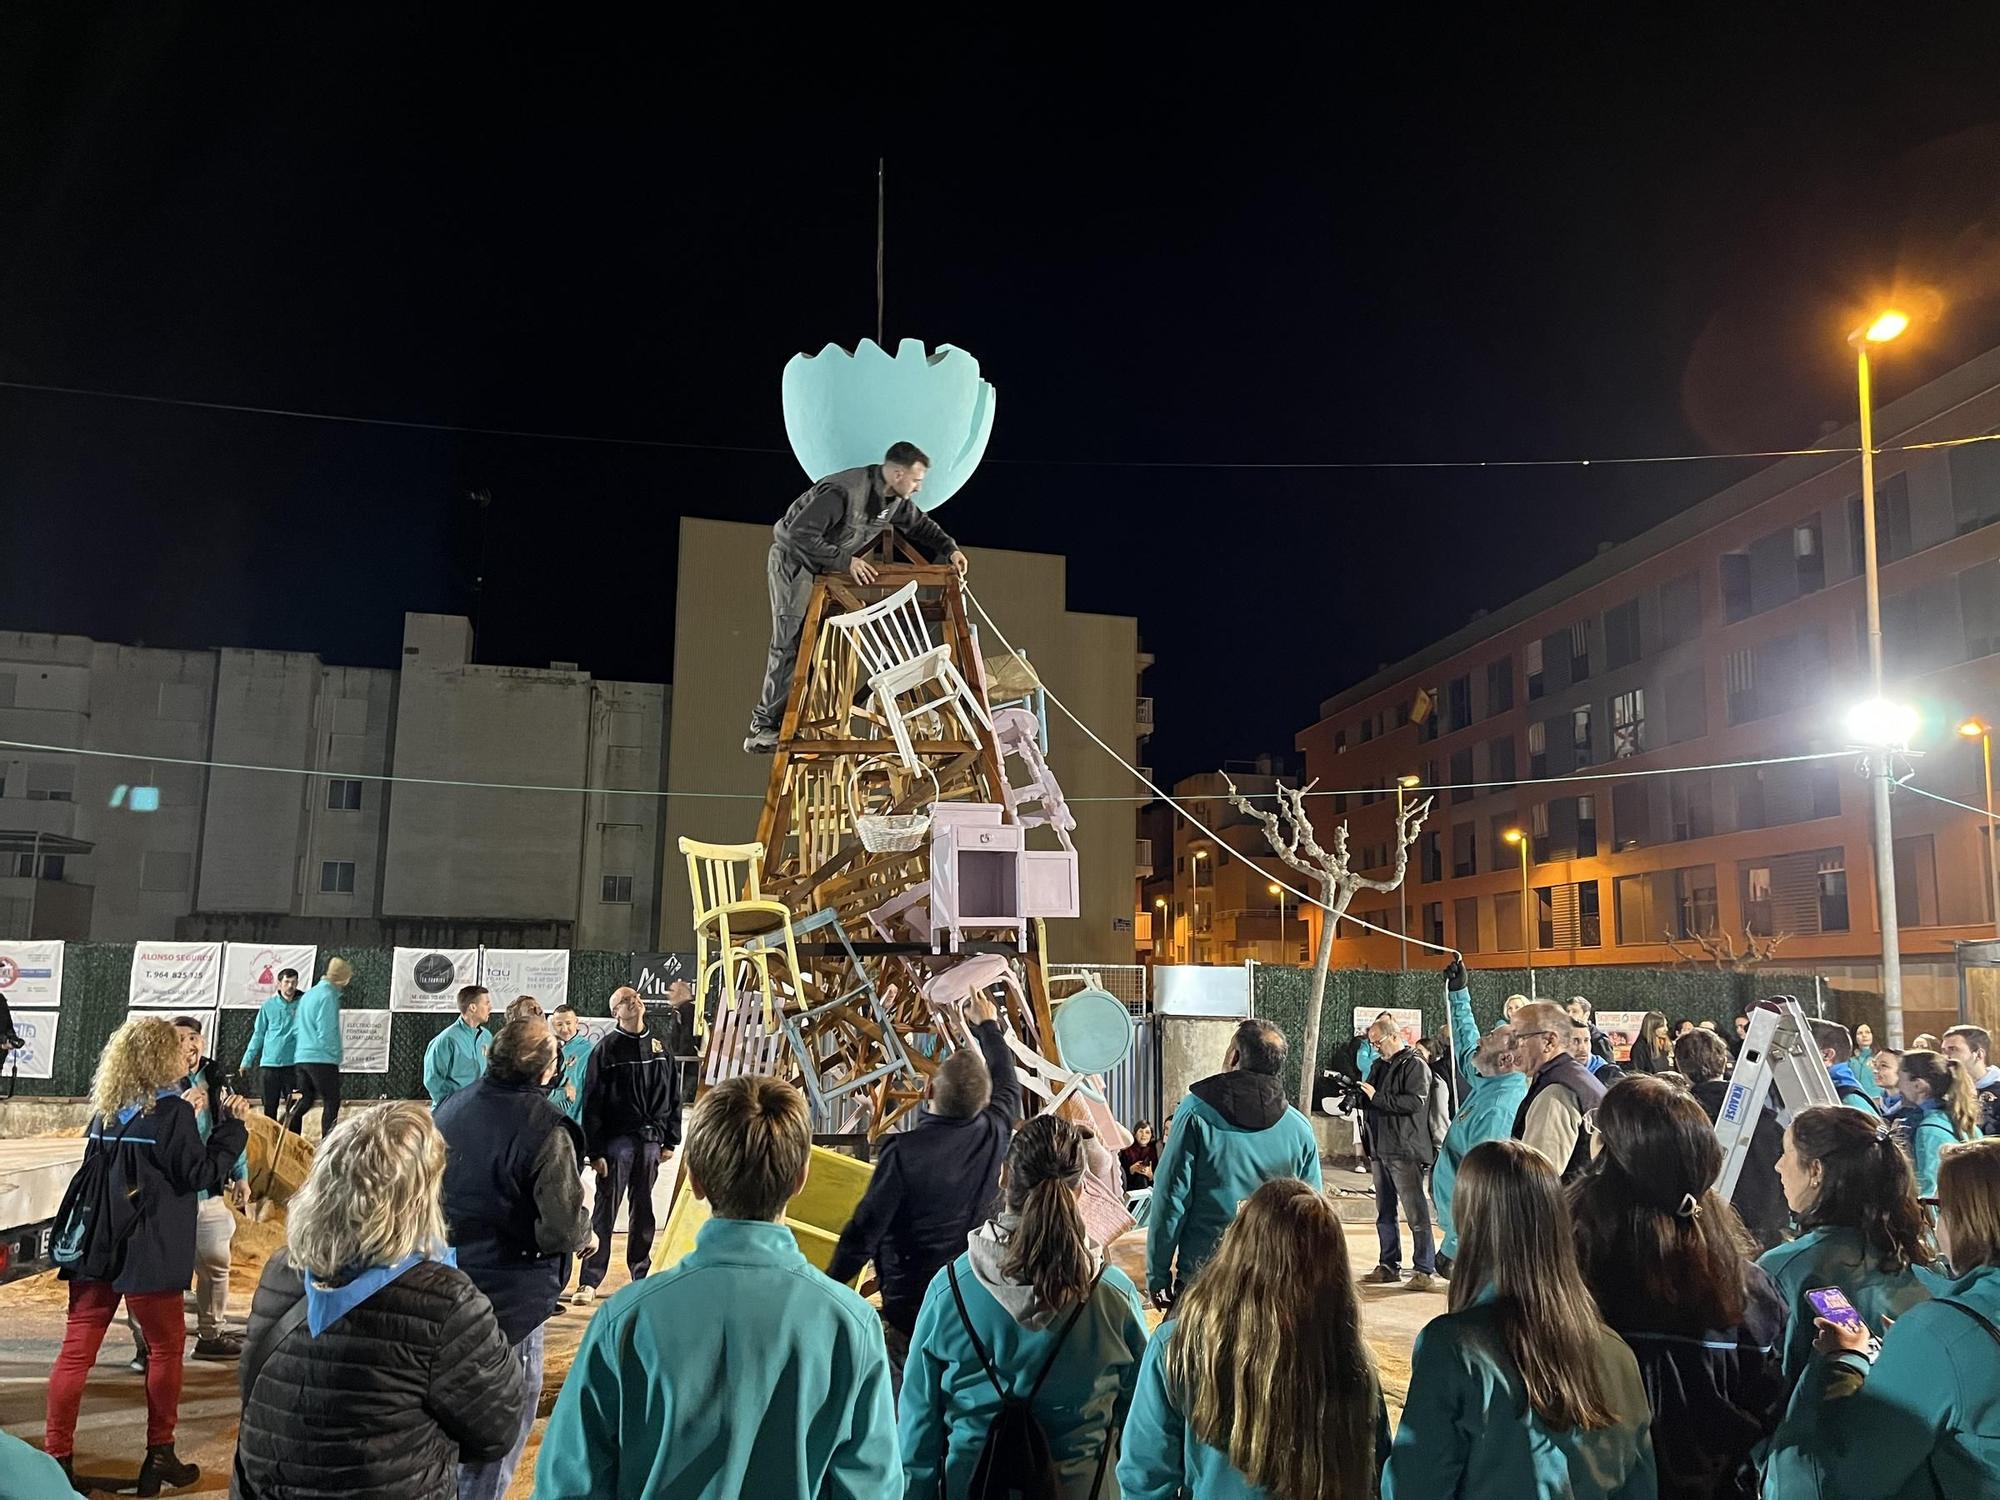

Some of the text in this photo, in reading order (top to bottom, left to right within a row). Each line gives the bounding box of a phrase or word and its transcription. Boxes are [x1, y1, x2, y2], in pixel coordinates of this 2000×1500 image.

[141, 953, 174, 961] ALONSO
[154, 971, 168, 979] 964
[487, 968, 510, 977] tau
[1725, 1086, 1744, 1120] KRAUSE
